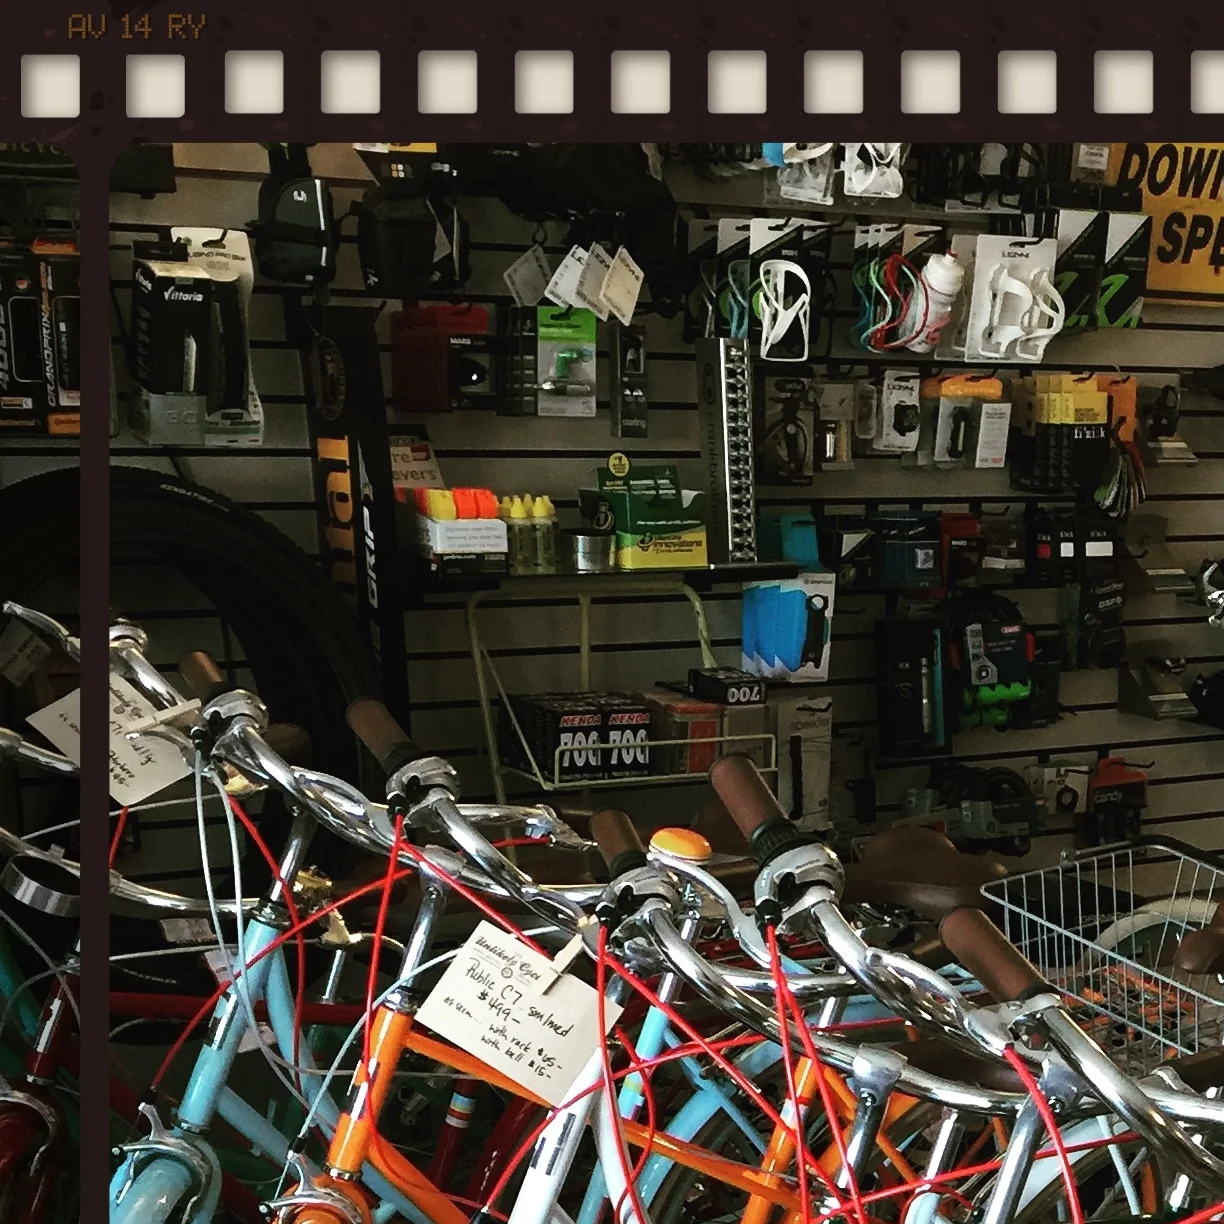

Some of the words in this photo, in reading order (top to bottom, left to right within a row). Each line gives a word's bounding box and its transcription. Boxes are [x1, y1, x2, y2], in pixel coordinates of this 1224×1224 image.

[163, 286, 203, 301] Vittoria
[559, 714, 601, 727] KENDA
[608, 712, 650, 725] KENDA
[474, 935, 518, 967] Unlikely
[510, 1035, 532, 1054] rack
[505, 1048, 524, 1063] bell
